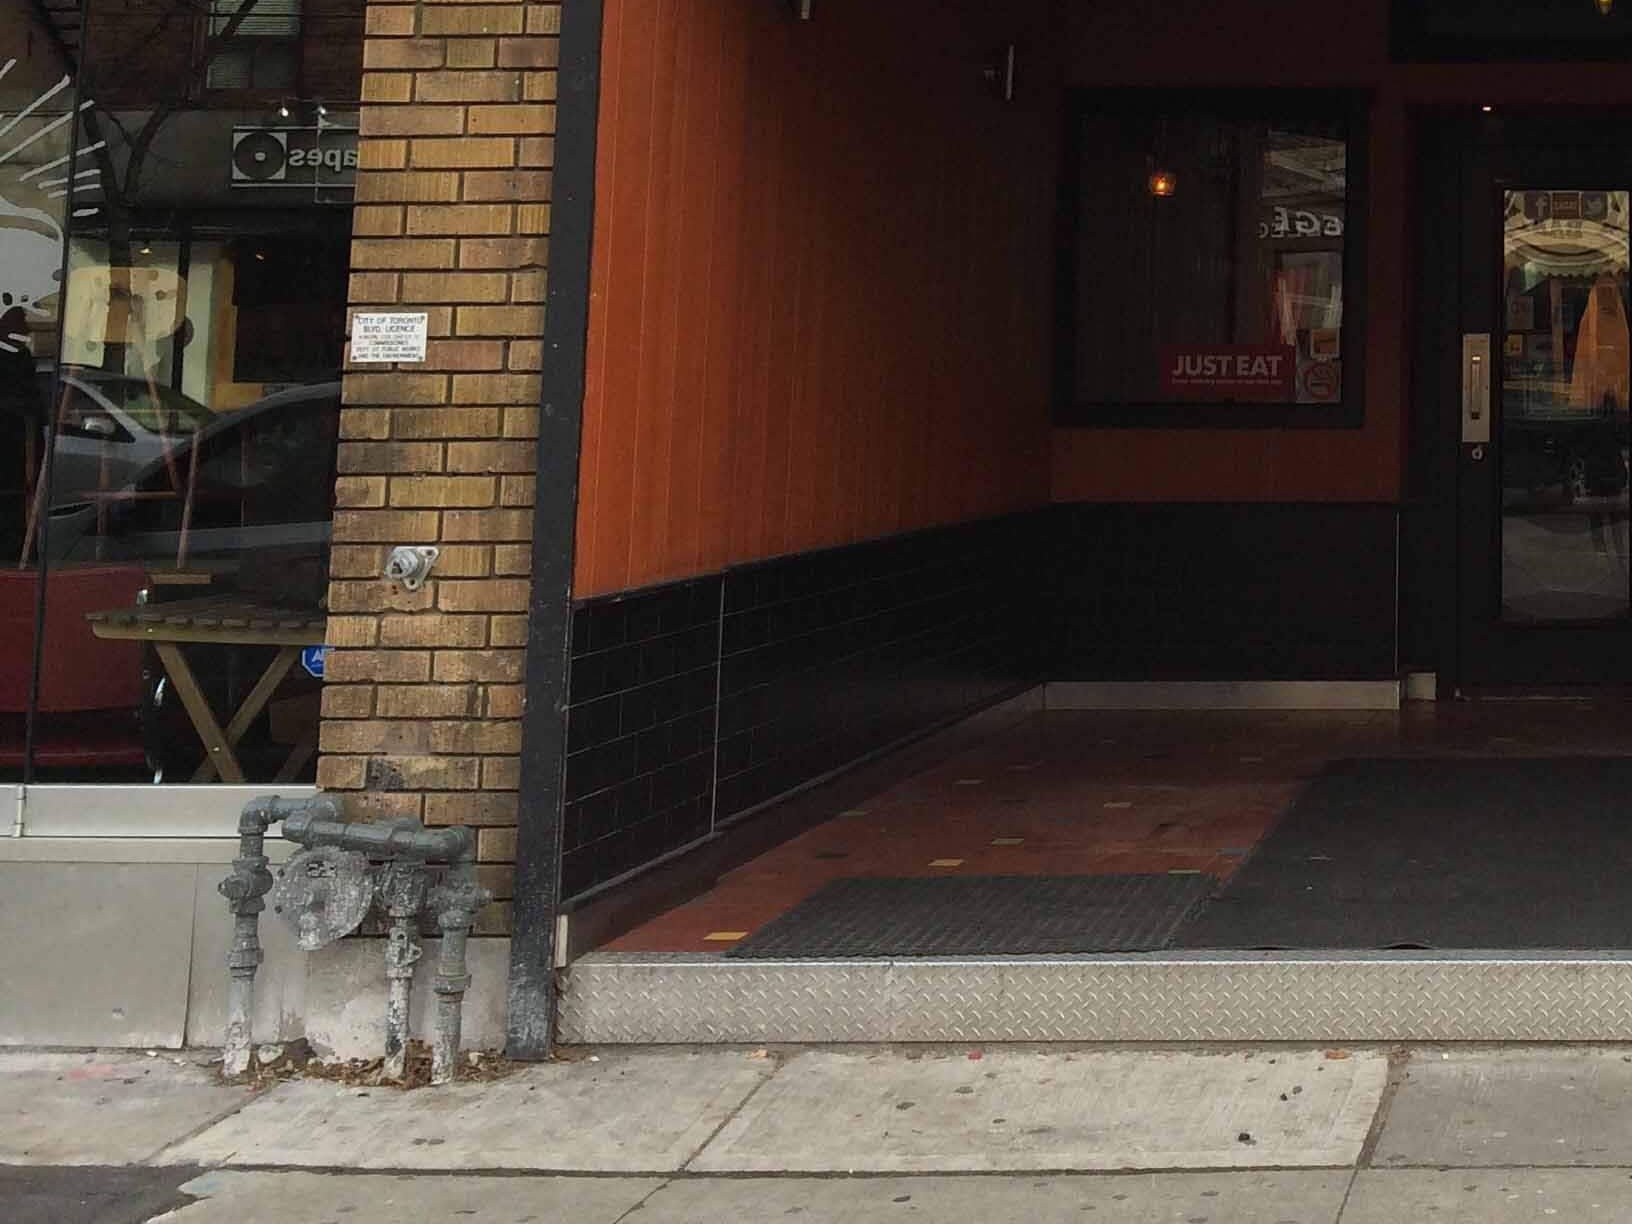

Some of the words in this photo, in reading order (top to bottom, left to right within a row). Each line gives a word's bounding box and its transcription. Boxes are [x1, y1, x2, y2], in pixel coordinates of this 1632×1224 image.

[385, 325, 416, 333] LICENCE
[1171, 354, 1233, 376] JUST
[1236, 354, 1284, 376] EAT
